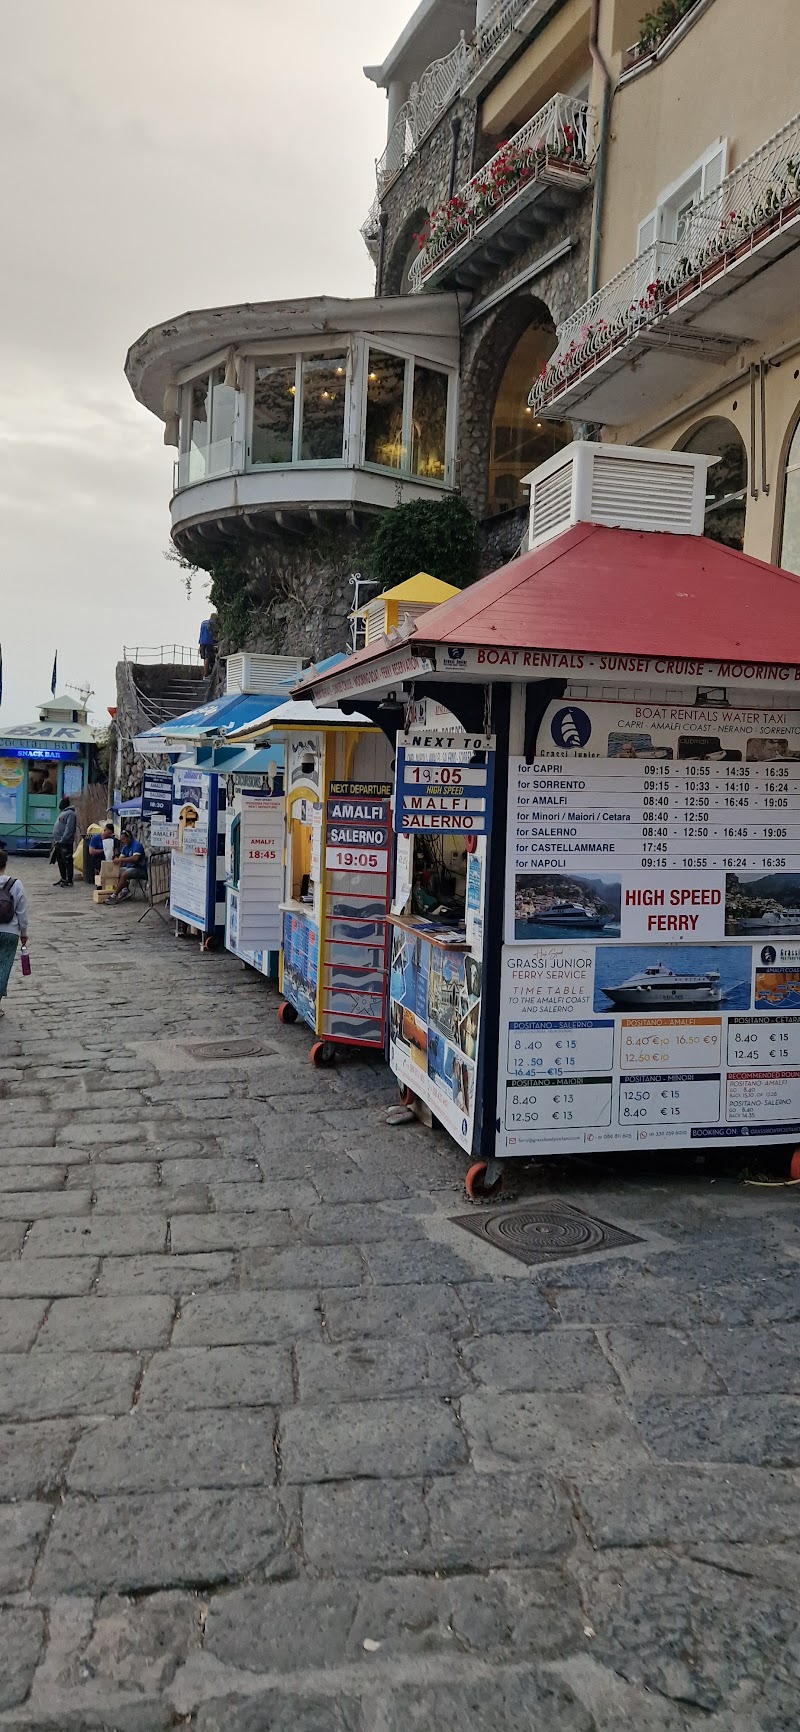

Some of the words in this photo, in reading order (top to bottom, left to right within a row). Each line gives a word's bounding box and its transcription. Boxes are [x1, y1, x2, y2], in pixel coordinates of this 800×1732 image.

[478, 648, 518, 664] BOAT
[523, 652, 584, 668] RENTALS
[599, 656, 652, 672] SUNSET
[655, 660, 704, 676] CRUISE
[718, 664, 790, 680] MOORING
[635, 708, 668, 718] BOAT
[670, 709, 718, 722] RENTALS
[722, 711, 759, 724] WATER
[763, 713, 786, 724] TAXI
[4, 726, 81, 738] BAR
[617, 720, 643, 729] CAPRI
[651, 722, 681, 731] AMALFI
[683, 724, 711, 732] COAST
[718, 725, 753, 734] NERANO
[759, 726, 800, 736] SORRENTO
[412, 736, 454, 748] NEXT
[464, 739, 482, 748] TO
[413, 767, 462, 784] 19:05
[518, 764, 530, 773] for
[533, 764, 562, 773] CAPRI
[644, 766, 670, 775] 09:15
[685, 766, 710, 775] 10:55
[726, 767, 750, 776] 14:35
[765, 768, 789, 776] 16:35
[330, 784, 349, 793] NEXT
[350, 784, 391, 795] DEPARTURE
[426, 786, 442, 794] HIGH
[443, 786, 464, 795] SPEED
[518, 781, 530, 789] for
[533, 781, 586, 789] SORRENTO
[644, 781, 669, 790] 09:15
[685, 782, 710, 791] 10:33
[725, 782, 750, 791] 14:10
[765, 783, 788, 792] 16:24
[517, 796, 530, 805] for
[532, 797, 567, 805] AMALFI
[643, 797, 669, 806] 08:40
[685, 797, 709, 806] 12:50
[725, 798, 749, 806] 16:45
[764, 798, 788, 807] 19:05
[332, 805, 383, 819] AMALFI
[517, 812, 529, 820] for
[643, 812, 668, 821] 08:40
[684, 812, 709, 821] 12:50
[402, 814, 473, 828] SALERNO
[331, 829, 383, 844] SALERNO
[531, 828, 577, 836] SALERNO
[642, 828, 668, 836] 08:40
[684, 828, 708, 837] 12:50
[724, 828, 748, 837] 16:45
[763, 828, 787, 837] 19:05
[642, 843, 668, 852] 17:45
[249, 850, 276, 859] 18:45
[336, 853, 378, 867] 19:05
[516, 859, 528, 867] for
[531, 860, 566, 868] NAPOLI
[641, 858, 667, 867] 09:15
[683, 858, 707, 867] 10:55
[723, 858, 747, 867] 16:24
[762, 858, 786, 867] 16:35
[626, 890, 664, 905] HIGH
[670, 890, 721, 905] SPEED
[648, 915, 699, 930] FERRY
[507, 959, 547, 968] GRASSI
[551, 959, 592, 968] JUNIOR
[512, 971, 545, 979] FERRY
[546, 971, 586, 979] SERVICE
[566, 1040, 577, 1048] 15
[676, 1035, 700, 1044] 16.50
[735, 1034, 758, 1043] 8.40
[735, 1050, 759, 1060] 12.45
[555, 1057, 562, 1065] €
[565, 1057, 575, 1065] 15
[512, 1095, 537, 1105] 8.40
[553, 1095, 560, 1103] €
[624, 1091, 650, 1101] 12.50
[511, 1113, 539, 1122] 12.50
[552, 1112, 559, 1120] €
[563, 1111, 573, 1120] 13
[624, 1108, 647, 1118] 8.40
